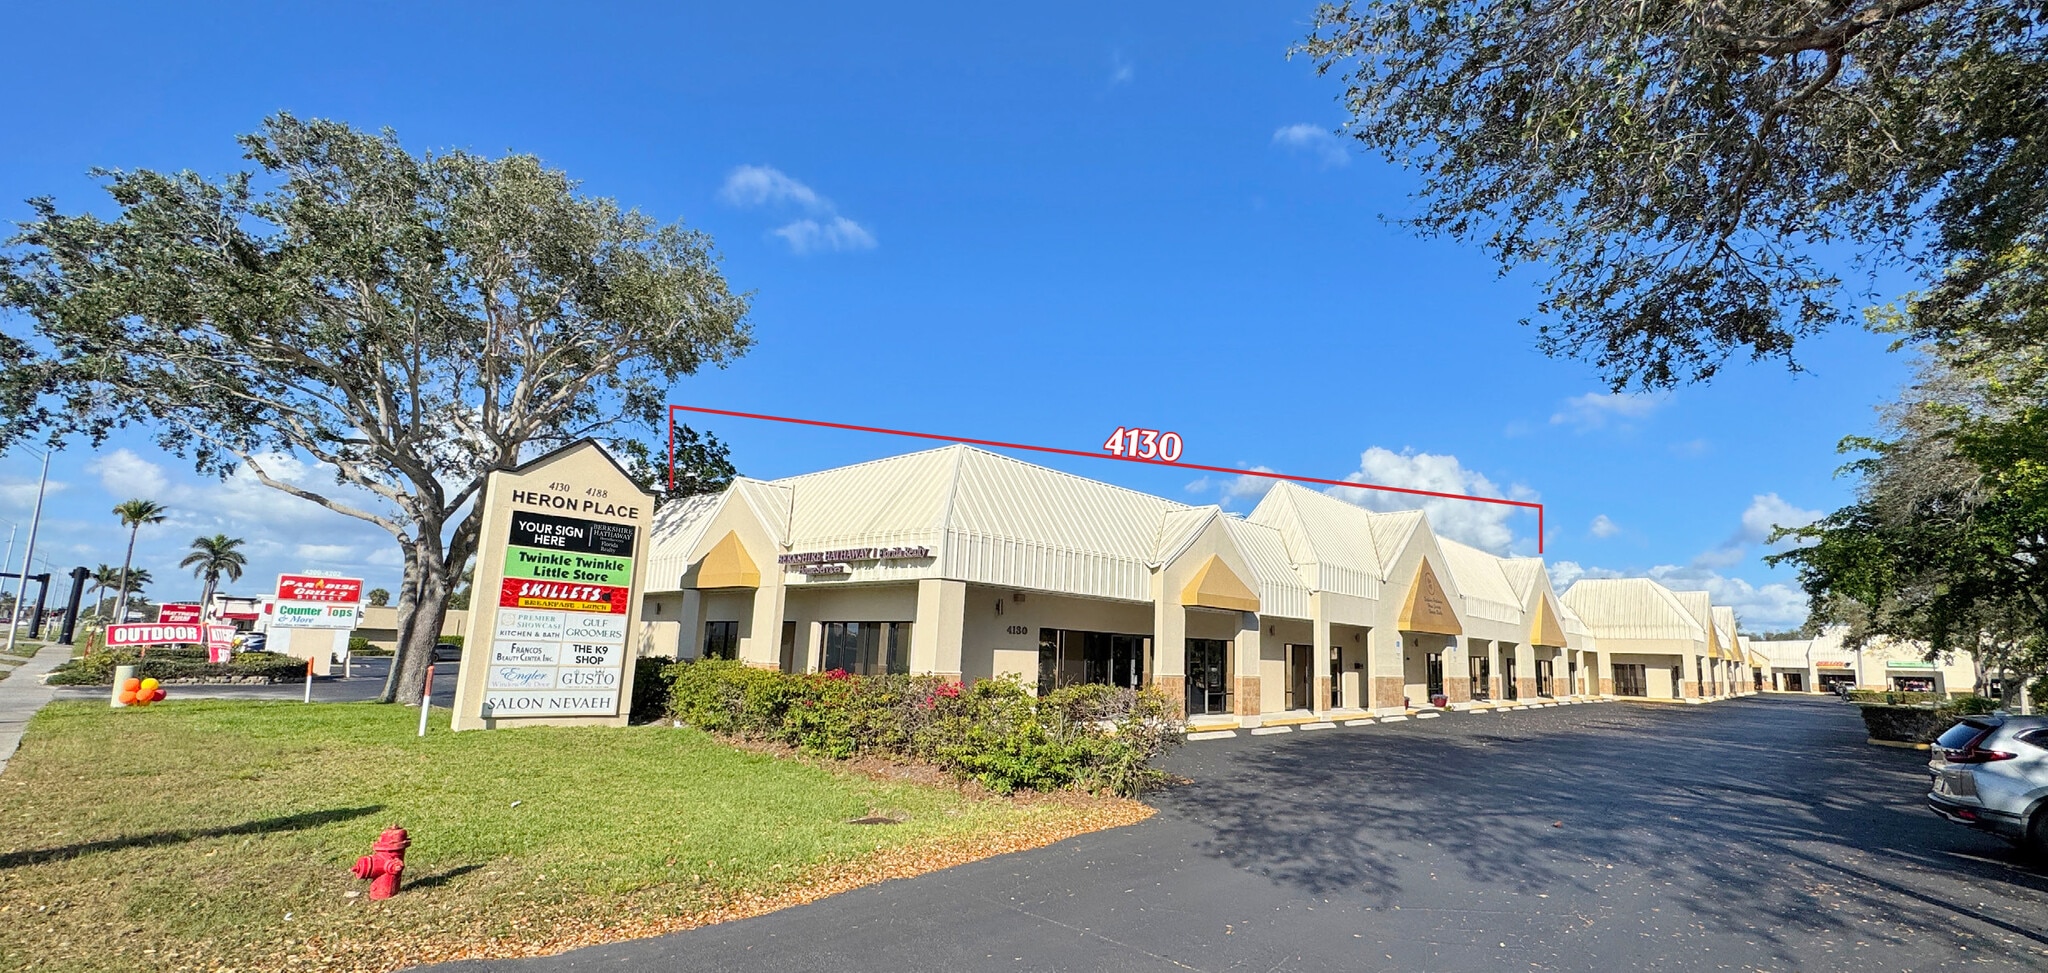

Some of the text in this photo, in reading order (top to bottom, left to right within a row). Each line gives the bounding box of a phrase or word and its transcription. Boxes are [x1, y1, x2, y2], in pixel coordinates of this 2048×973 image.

[549, 482, 608, 499] 4130 4188
[512, 489, 639, 519] HERON PLACE
[518, 520, 584, 538] YOUR SIGN
[593, 523, 633, 535] BERKSHIRE
[593, 529, 632, 540] HATHAWAY
[534, 534, 566, 547] HERE
[519, 551, 625, 571] Twinkle Twinkle
[824, 548, 872, 562] HATHAWAY
[533, 566, 609, 582] Little Store
[518, 582, 601, 601] SKILLETS
[280, 605, 355, 618] Counter Tops
[518, 614, 556, 622] PREMIER
[582, 618, 609, 628] GULF
[114, 626, 198, 642] OUTDOOR
[566, 628, 622, 638] GROOMERS
[1007, 625, 1028, 635] 4130
[573, 644, 609, 654] THE K9
[575, 656, 604, 665] SHOP
[500, 667, 547, 685] Engler
[561, 671, 615, 685] GUSTO
[487, 697, 611, 710] SALON NEVAEH
